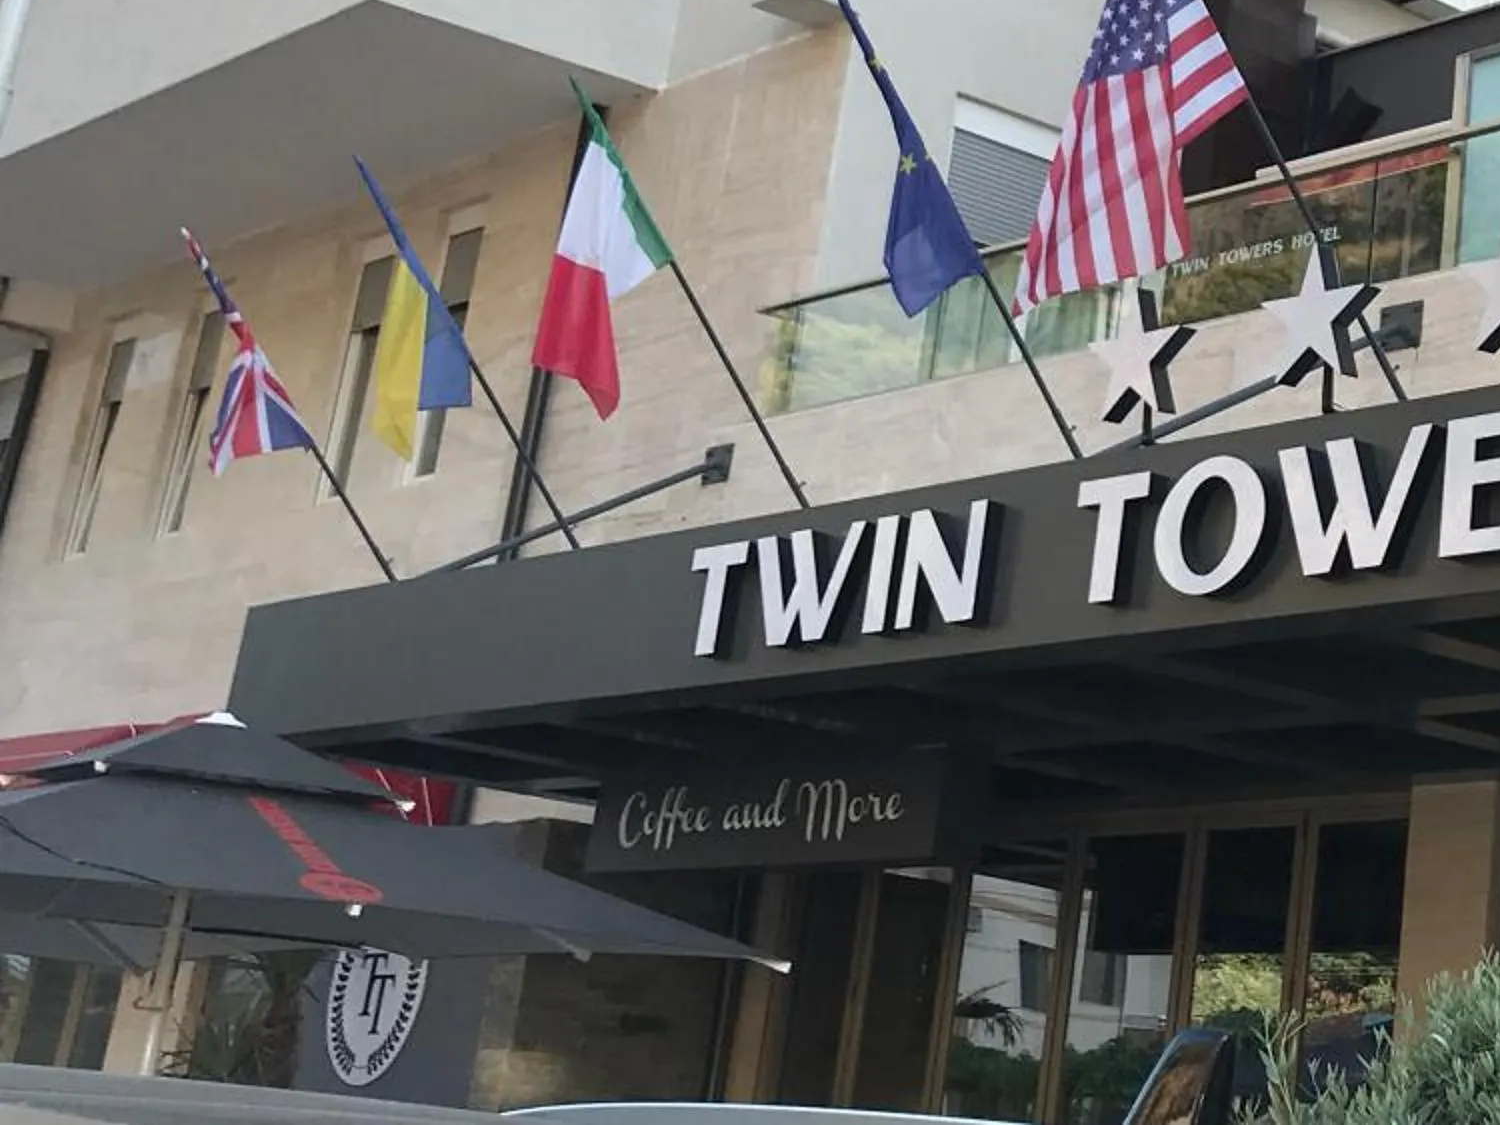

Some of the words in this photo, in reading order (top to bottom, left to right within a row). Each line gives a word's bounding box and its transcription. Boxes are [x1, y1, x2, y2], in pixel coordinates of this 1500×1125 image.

[1172, 256, 1212, 278] TWIN
[1218, 238, 1284, 266] TOWERS
[690, 498, 992, 657] TWIN
[617, 786, 713, 851] Coffee
[721, 778, 790, 830] and
[796, 777, 905, 843] More
